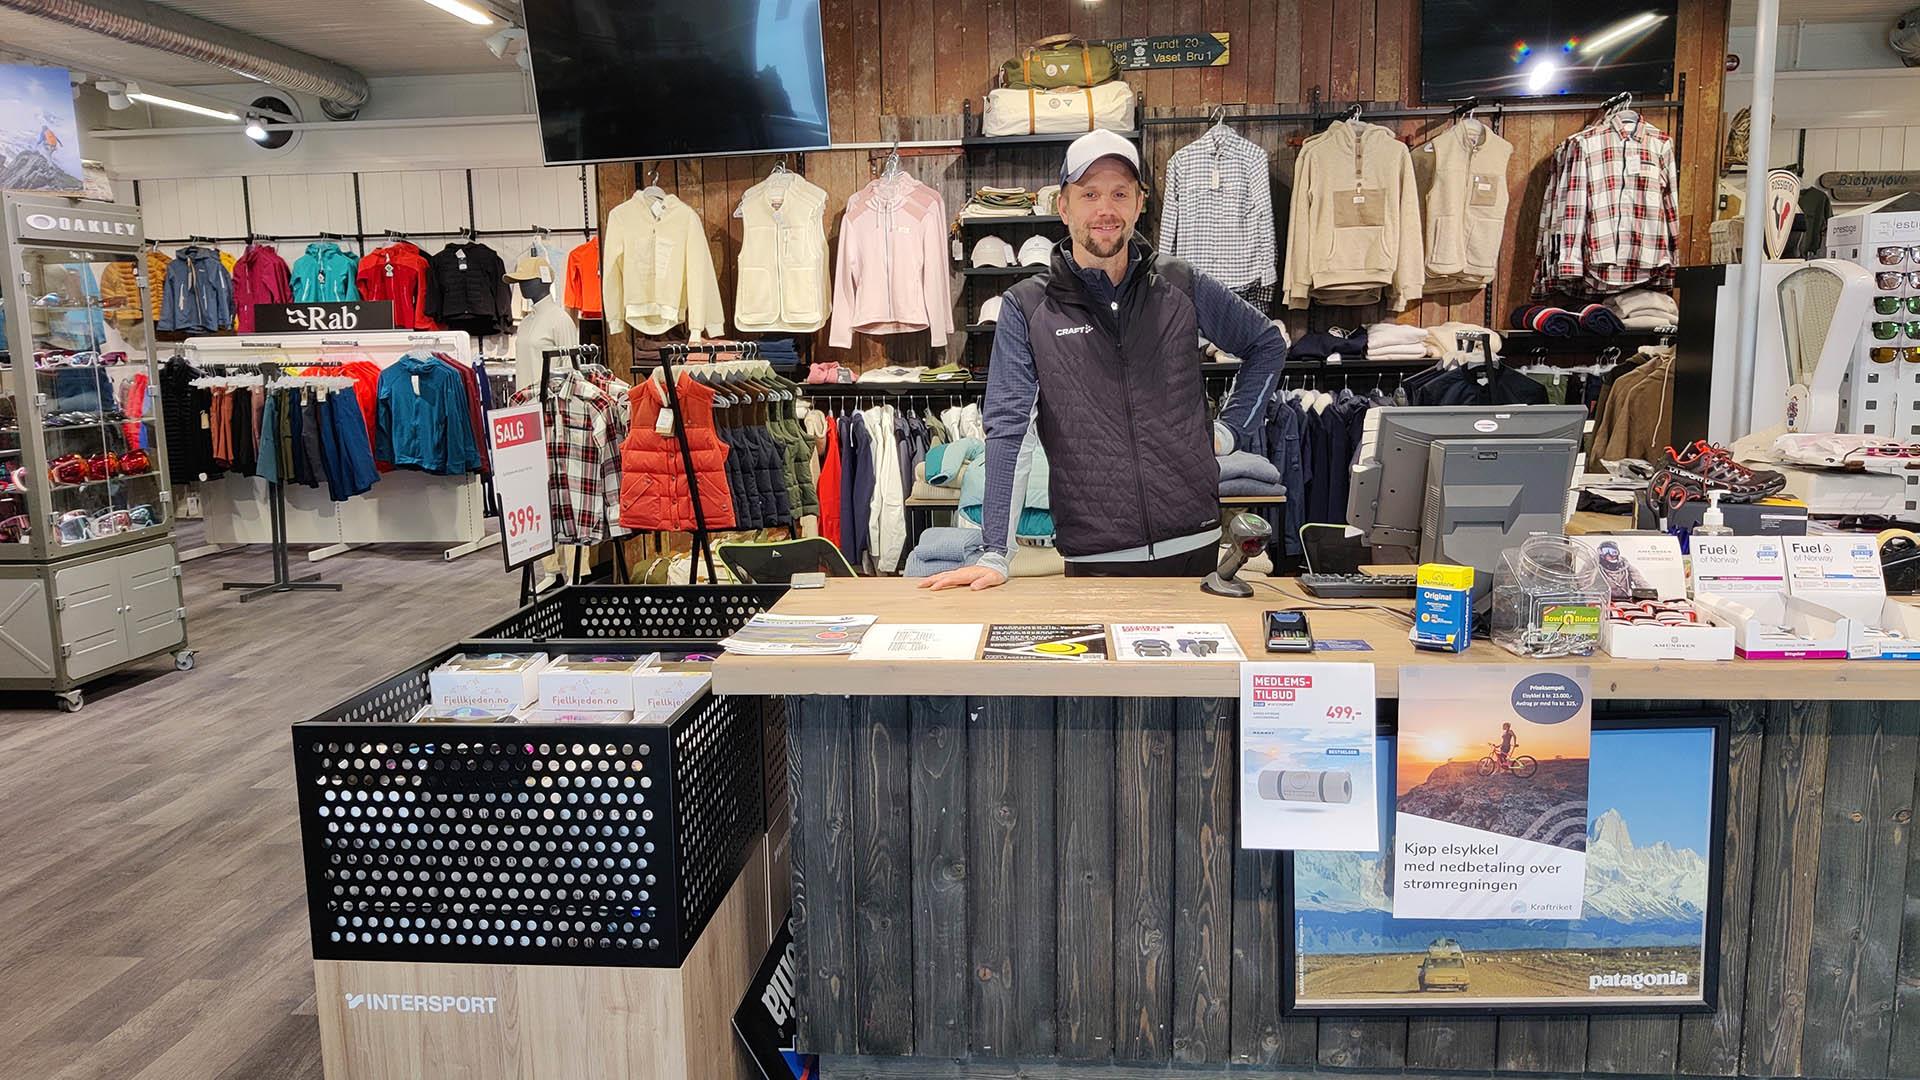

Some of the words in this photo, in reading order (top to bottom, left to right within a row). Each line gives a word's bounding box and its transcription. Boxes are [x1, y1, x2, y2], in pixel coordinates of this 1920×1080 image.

[1153, 39, 1179, 49] rundt
[1153, 53, 1181, 63] Vaset
[1186, 51, 1204, 61] Bru
[58, 217, 136, 236] OAKLEY
[1833, 225, 1857, 235] prestige
[307, 306, 358, 330] Rab
[1056, 326, 1085, 337] CRAFT
[495, 421, 525, 445] SALG
[508, 505, 542, 538] 399,-
[1699, 545, 1727, 555] Fuel
[1793, 544, 1821, 553] Fuel
[1710, 556, 1739, 564] Norway
[1793, 554, 1802, 562] of
[1804, 554, 1833, 563] Norway
[1424, 592, 1452, 601] Original
[1255, 677, 1310, 687] MEDLEMS-
[444, 695, 509, 706] Fjellkjeden.no
[552, 695, 618, 706] Fjellkjeden.no
[1255, 690, 1294, 700] TILBUD
[1326, 706, 1362, 721] 499,-
[1404, 842, 1437, 858] Kjøp
[1441, 844, 1499, 857] elsykkel
[1404, 862, 1435, 873] med
[1439, 862, 1525, 876] nedbetaling
[1530, 864, 1562, 874] over
[1403, 880, 1518, 894] strømregningen
[1530, 902, 1573, 911] Kraftriket
[1588, 970, 1688, 990] patagonia
[366, 993, 498, 1014] INTERSPORT
